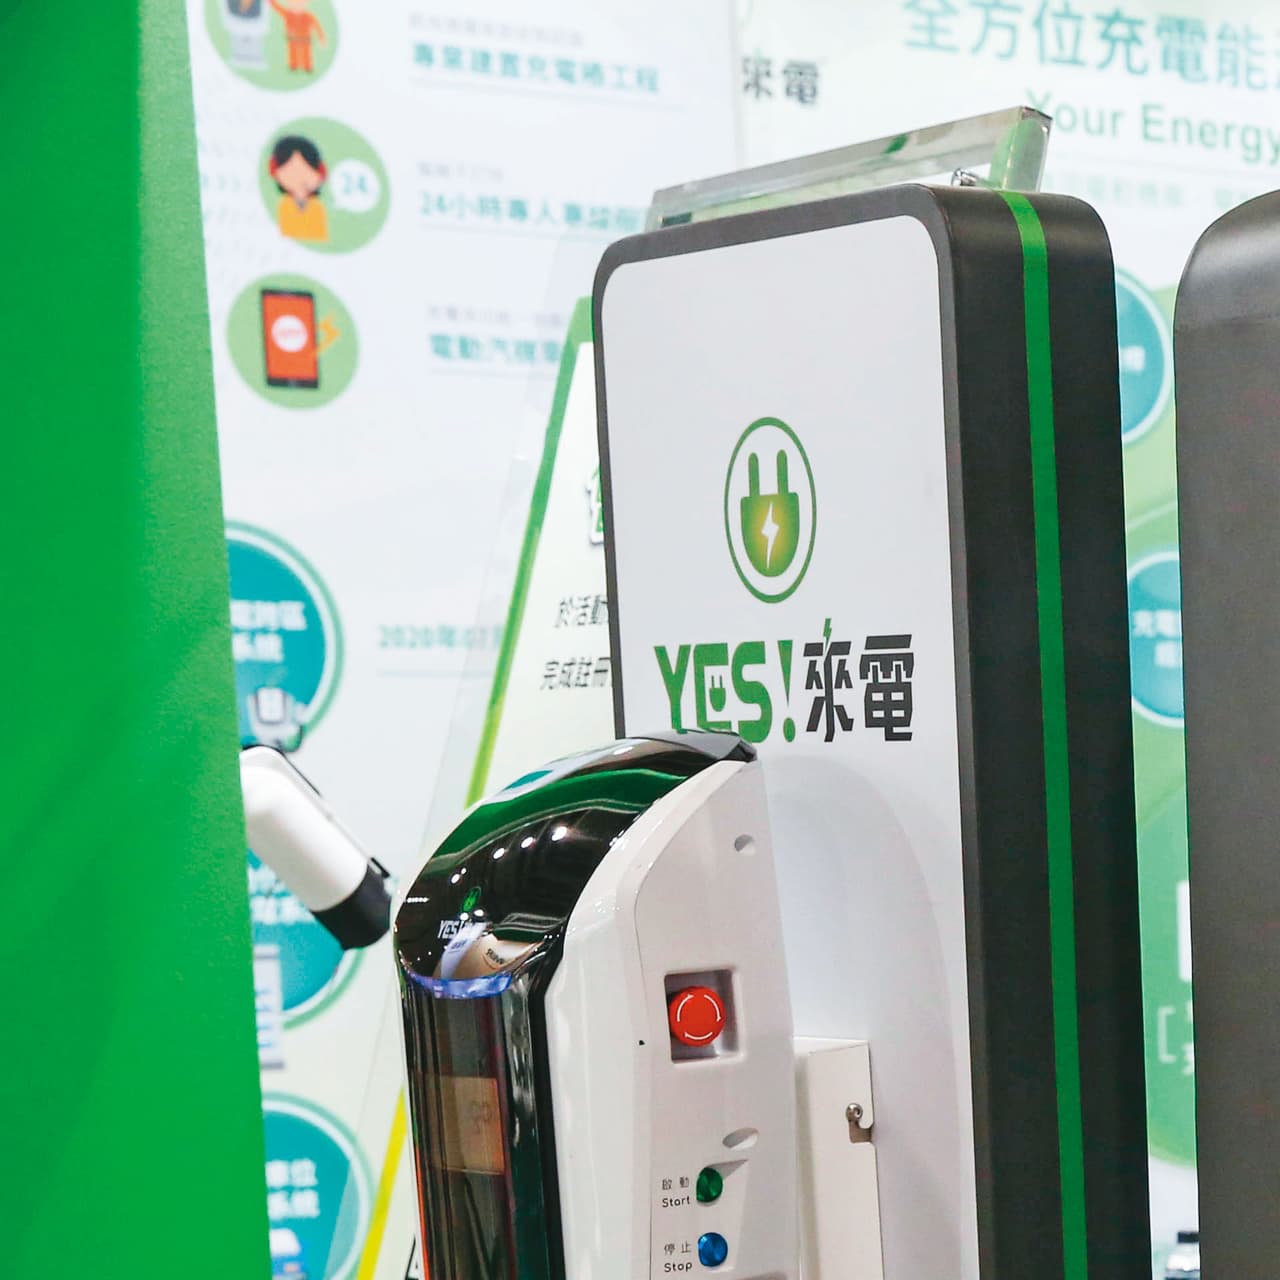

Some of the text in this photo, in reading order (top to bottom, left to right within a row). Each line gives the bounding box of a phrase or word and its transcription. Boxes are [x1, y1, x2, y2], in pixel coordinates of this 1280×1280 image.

[1026, 88, 1124, 138] Your
[662, 1196, 690, 1208] Start
[664, 1262, 692, 1273] Stop
